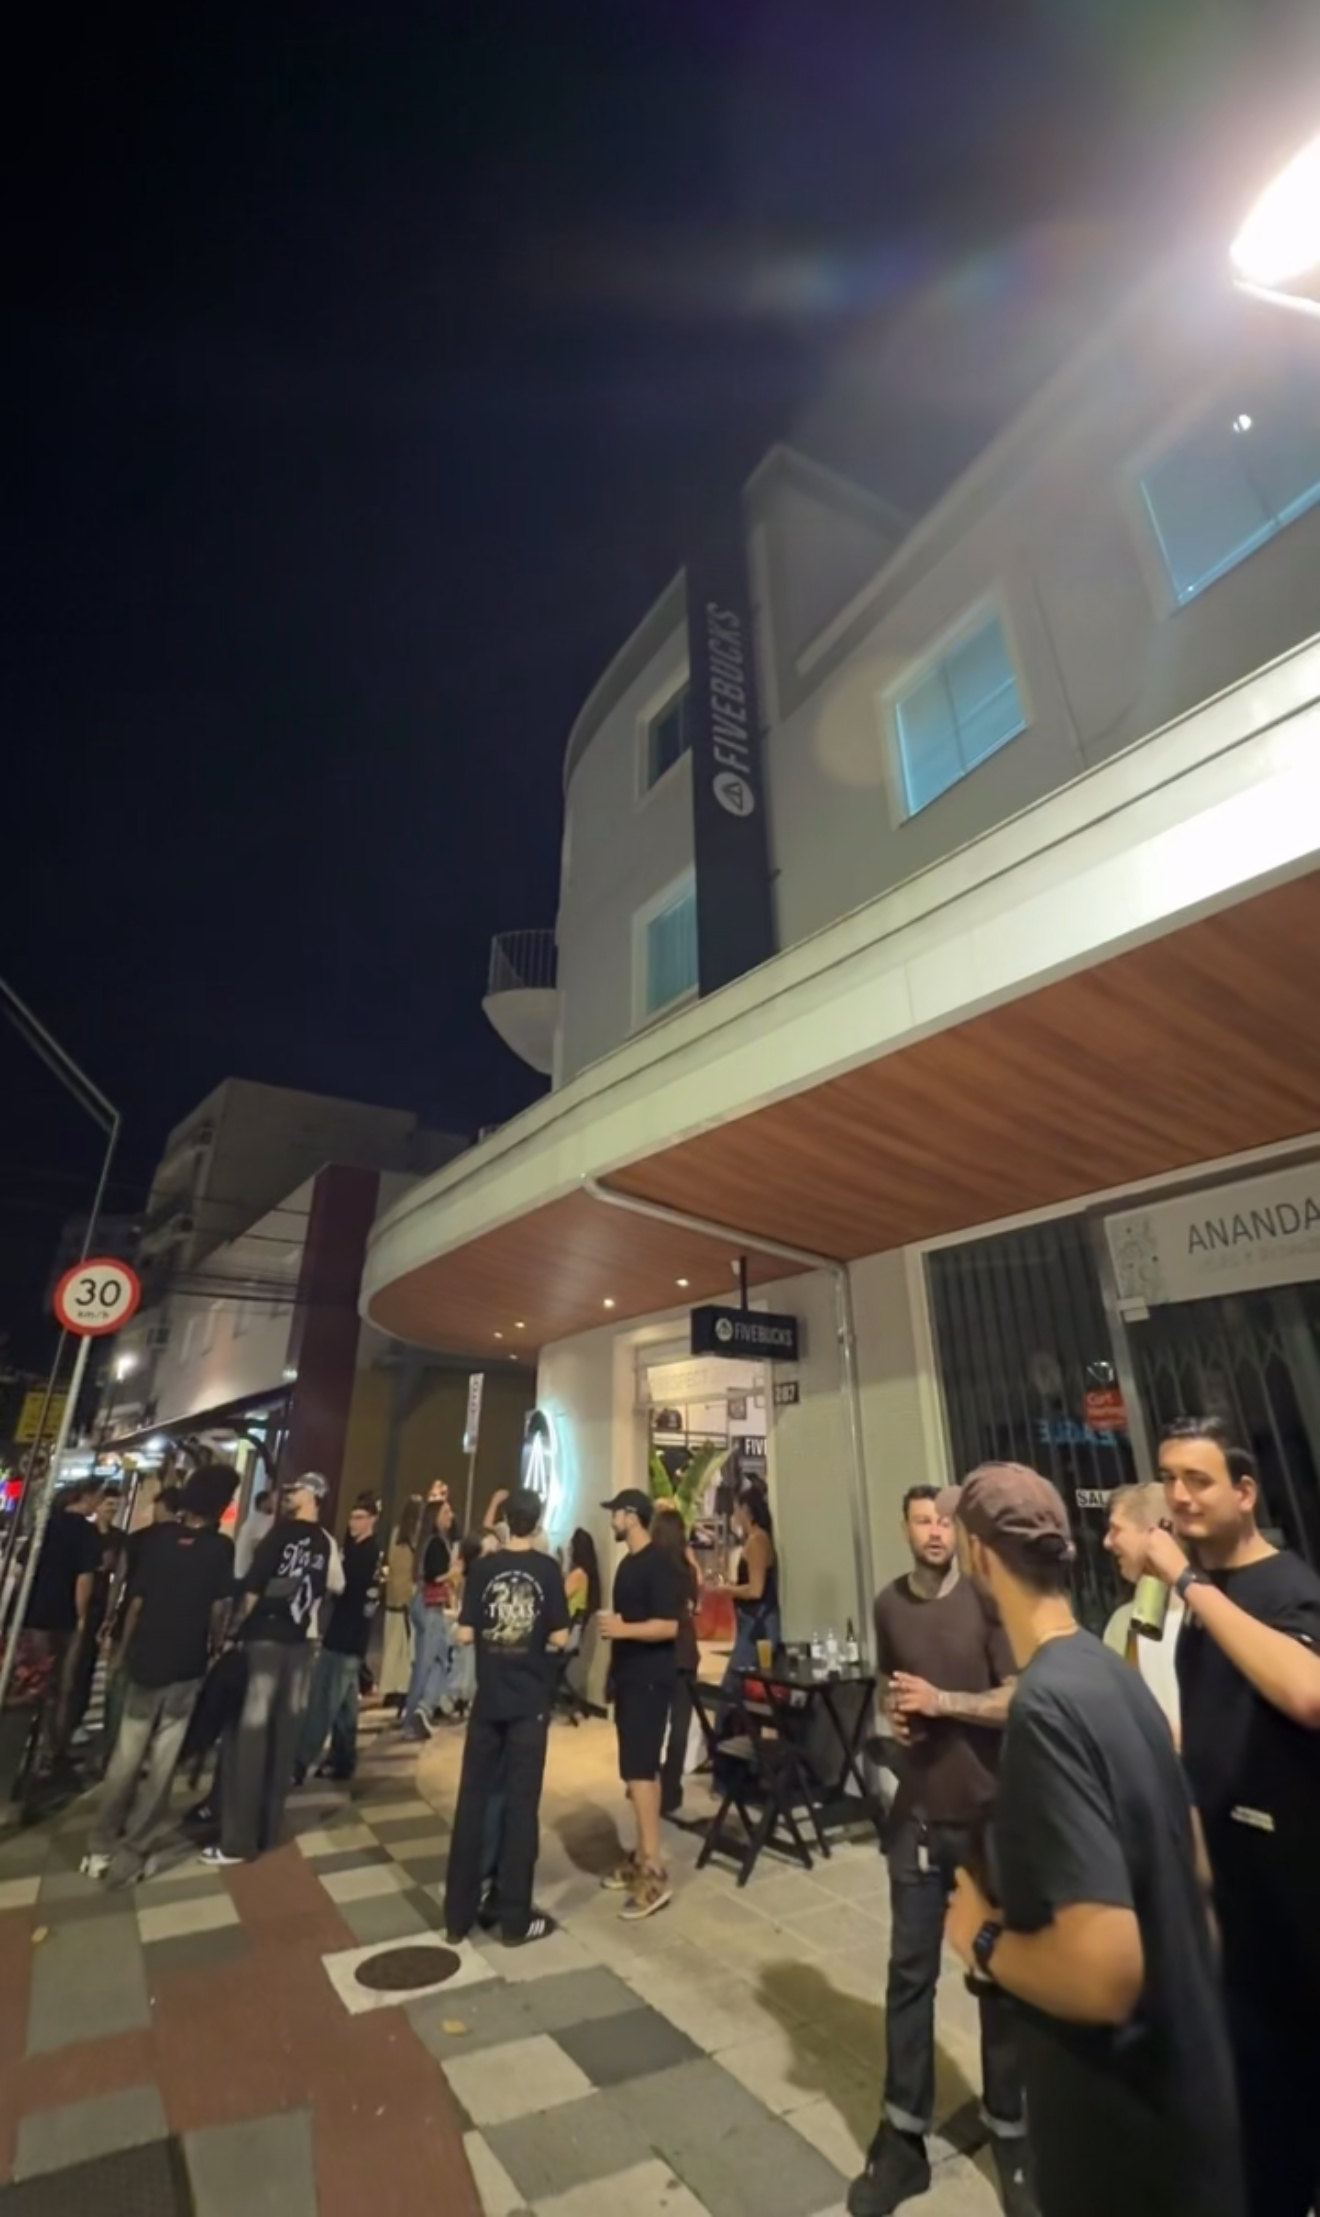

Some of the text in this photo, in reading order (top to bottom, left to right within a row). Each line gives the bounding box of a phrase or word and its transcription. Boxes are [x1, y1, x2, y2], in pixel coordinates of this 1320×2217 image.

[705, 602, 751, 774] FIVEBUCKS
[1187, 1196, 1320, 1255] ANANDA
[75, 1278, 121, 1308] 30
[734, 1322, 793, 1347] FIVEBUCKS
[1077, 1490, 1107, 1506] SAL
